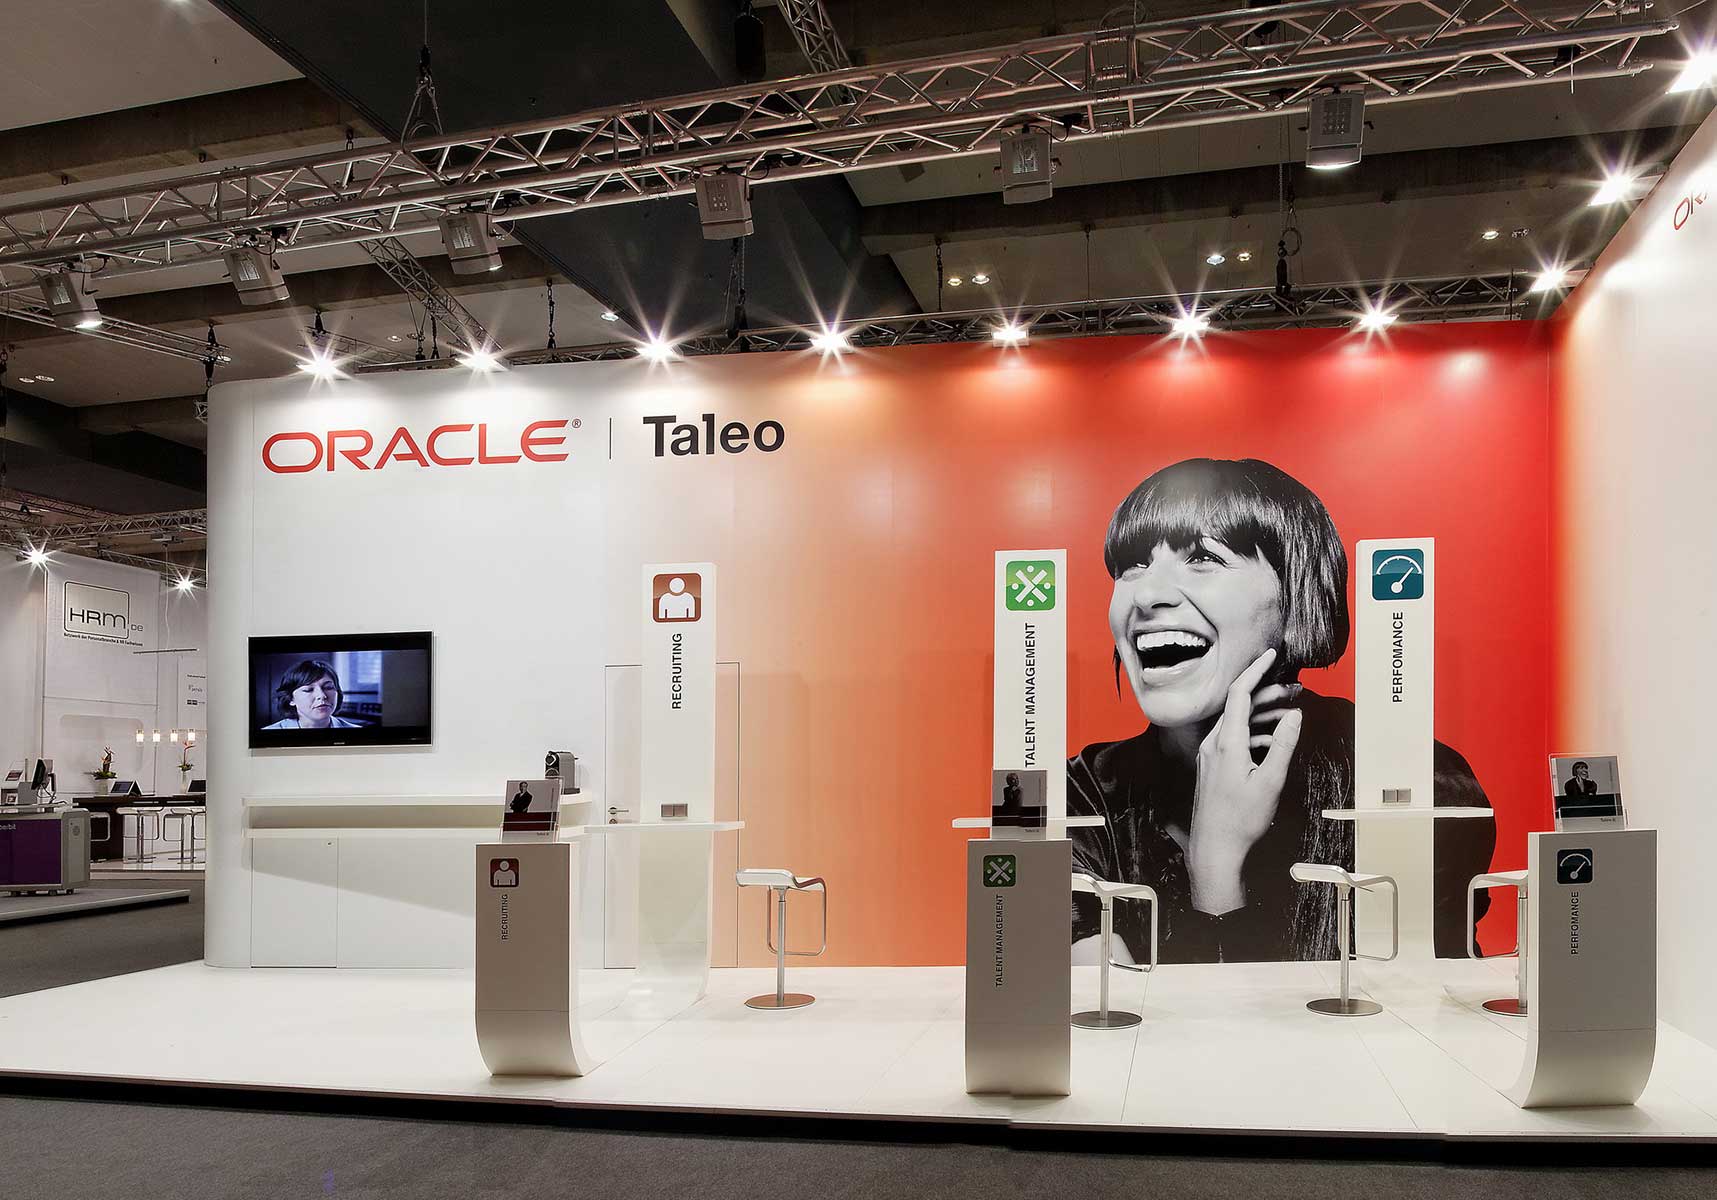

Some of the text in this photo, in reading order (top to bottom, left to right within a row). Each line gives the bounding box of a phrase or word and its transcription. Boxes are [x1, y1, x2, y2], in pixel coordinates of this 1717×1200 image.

[643, 414, 785, 458] Taleo
[671, 633, 683, 710] RECRUITING
[1024, 622, 1036, 768] TALENT MANAGEMENT
[1392, 611, 1404, 703] PERFOMANCE
[501, 894, 509, 941] RECRUITING
[995, 893, 1004, 988] TALENT MANAGEMENT
[1570, 891, 1579, 955] PERFOMANCE
